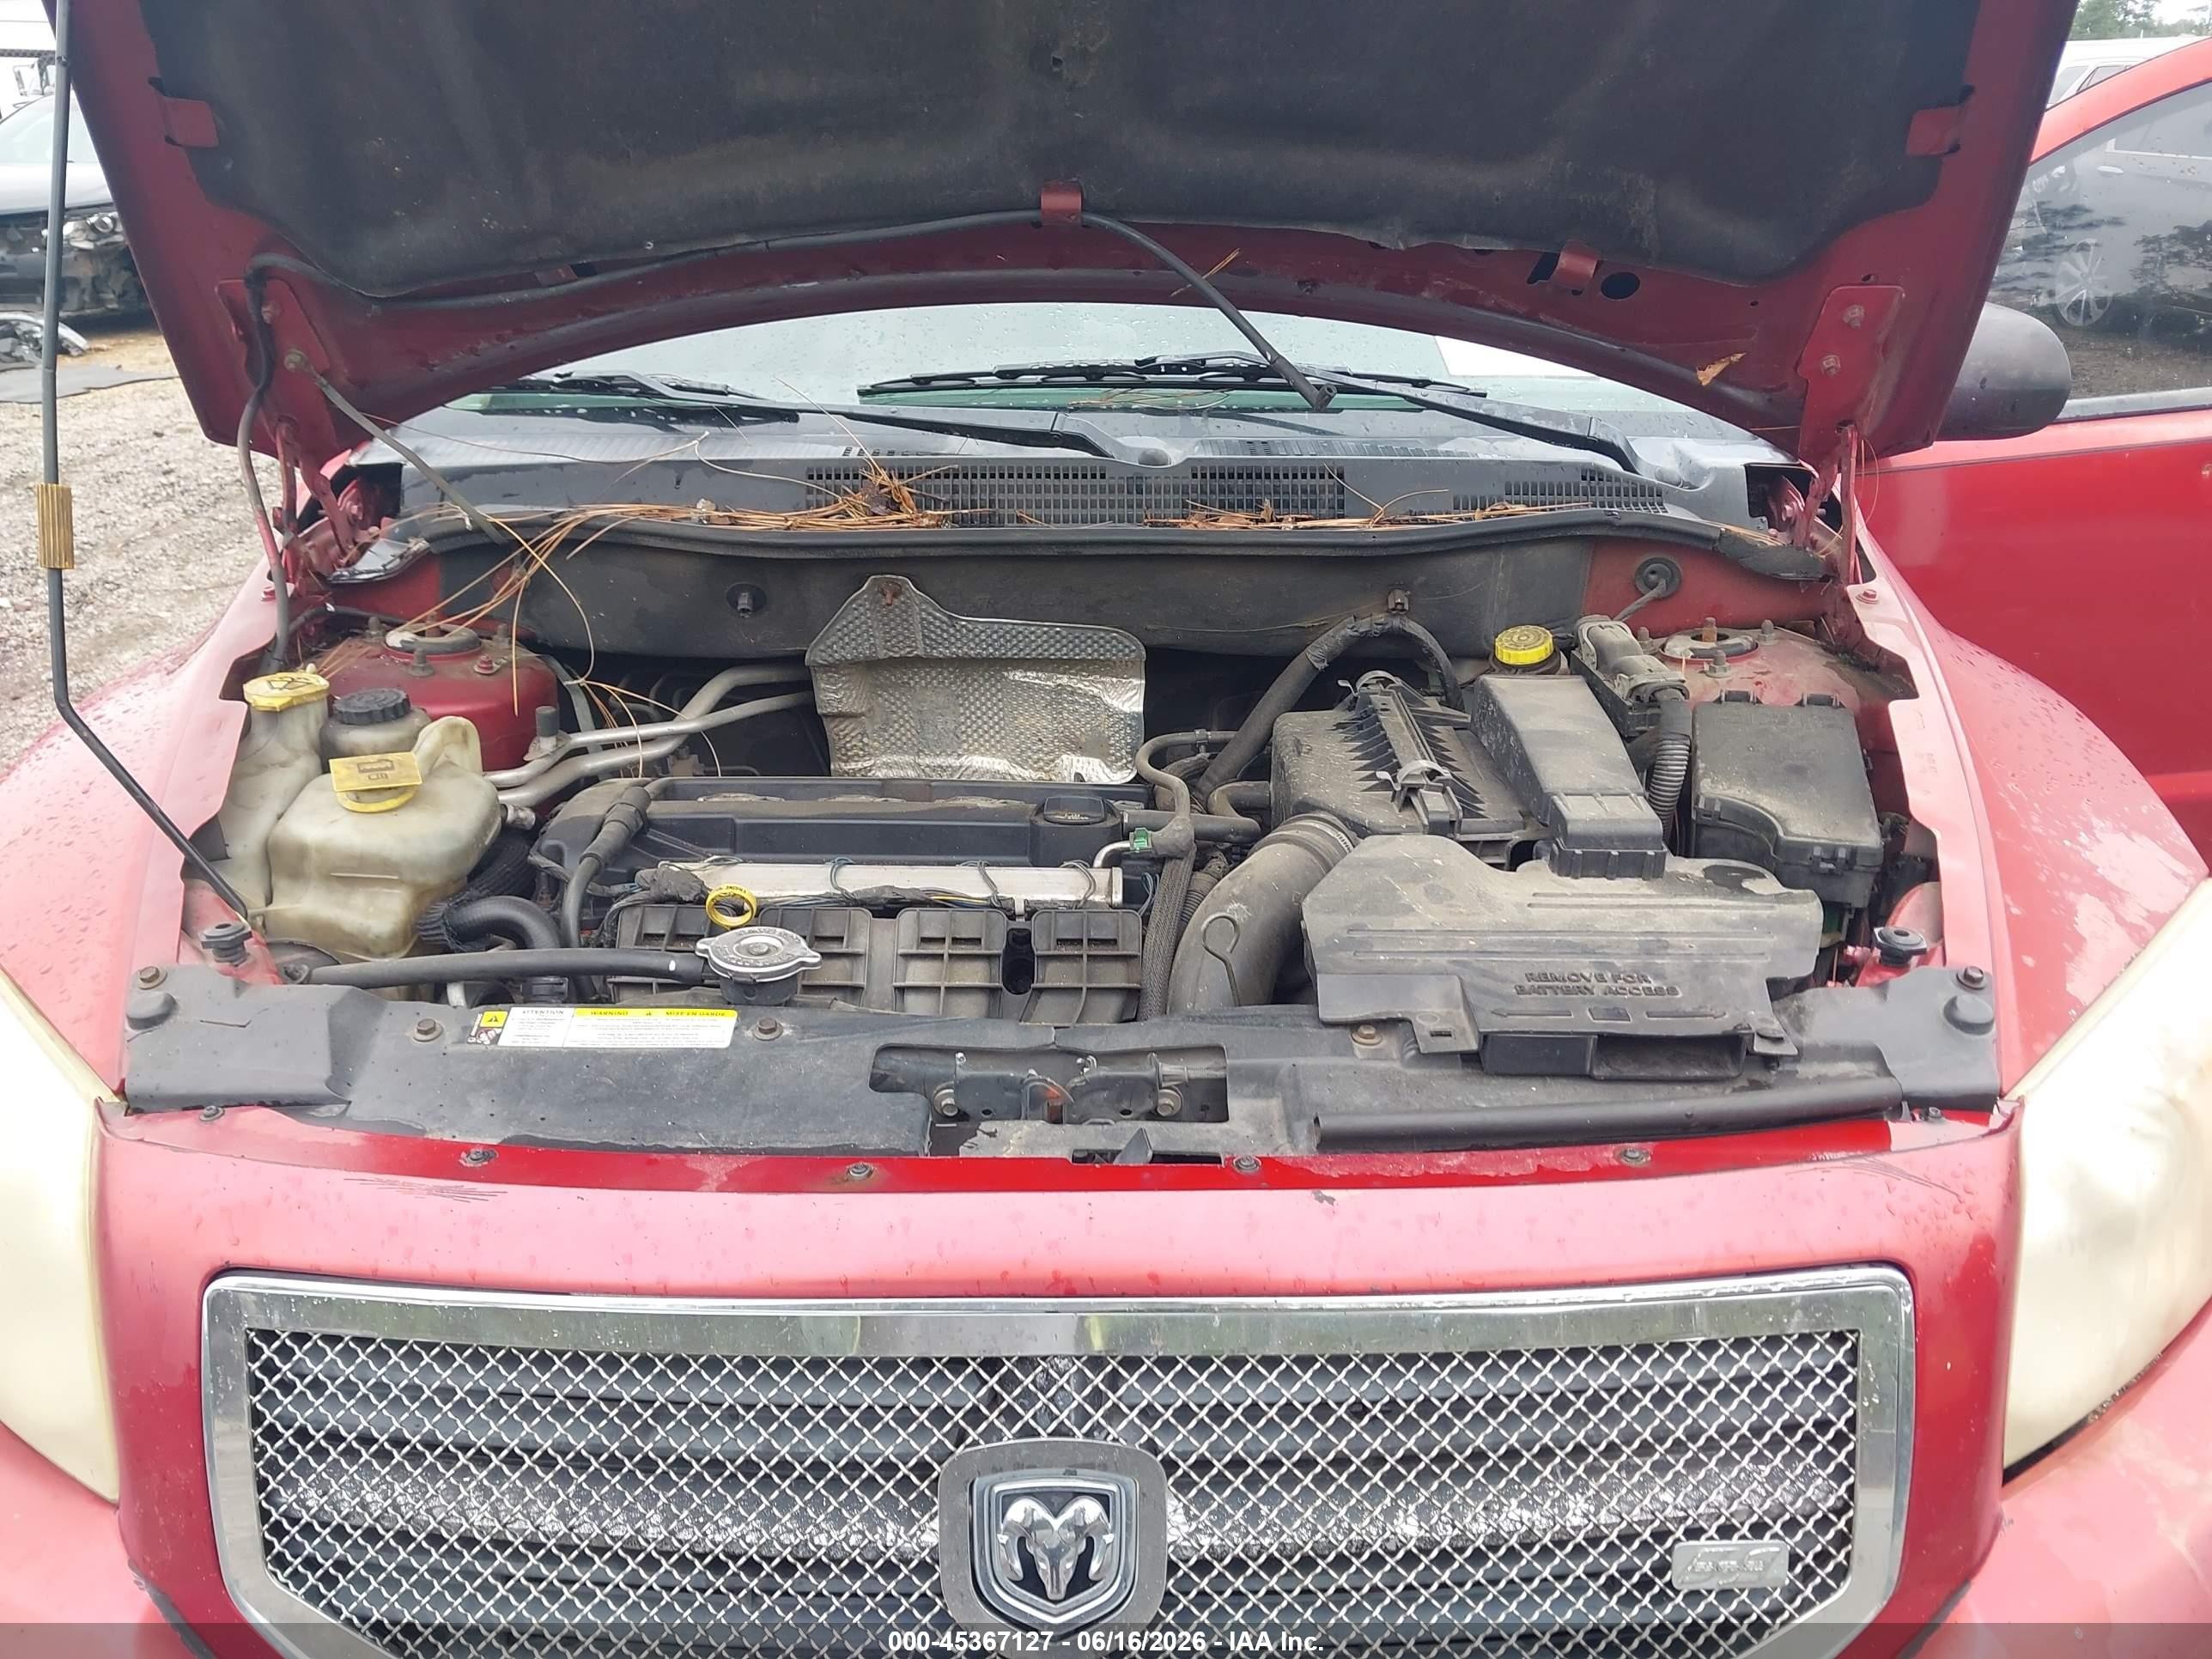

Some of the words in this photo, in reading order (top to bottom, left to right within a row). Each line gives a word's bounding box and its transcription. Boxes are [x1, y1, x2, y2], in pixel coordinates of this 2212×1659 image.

[1524, 972, 1608, 984] REMOVE
[1610, 973, 1653, 985] FOR
[1513, 984, 1595, 996] BATTERY
[1602, 985, 1683, 997] ACCESS
